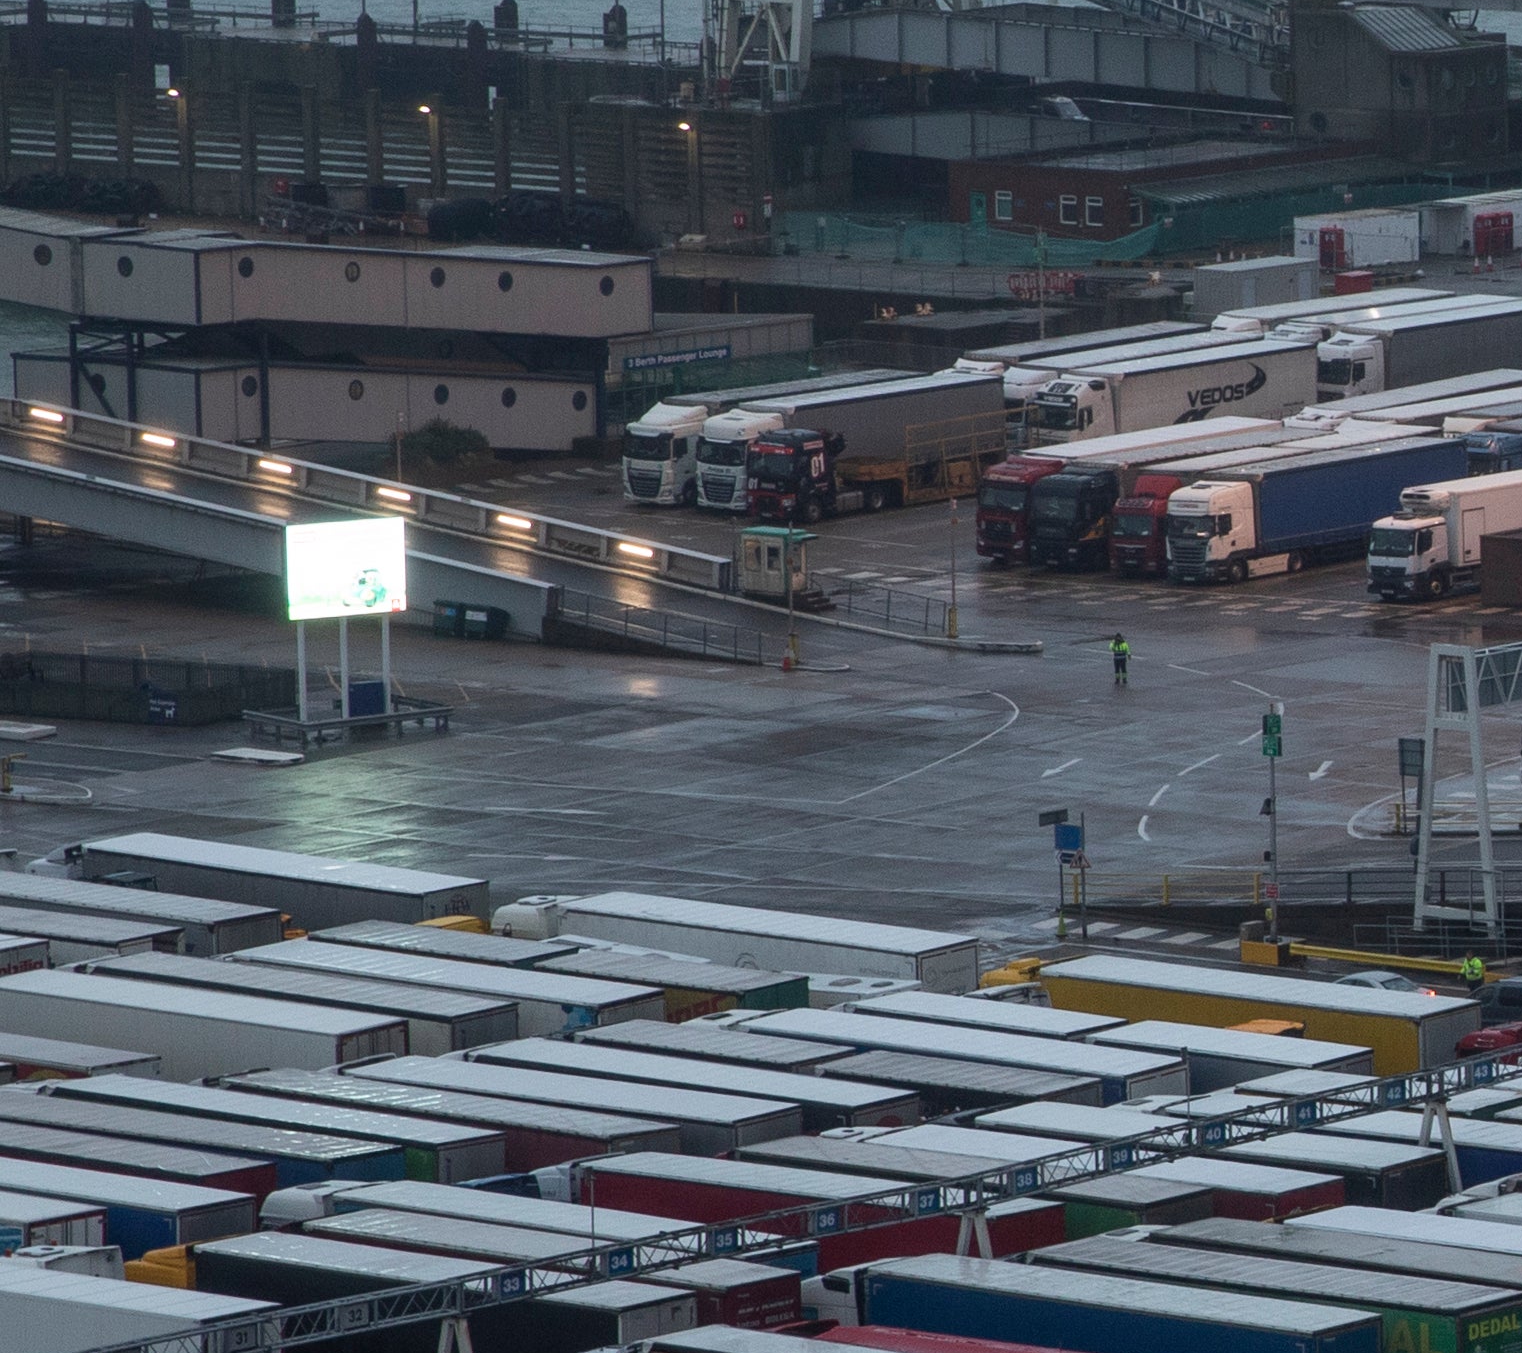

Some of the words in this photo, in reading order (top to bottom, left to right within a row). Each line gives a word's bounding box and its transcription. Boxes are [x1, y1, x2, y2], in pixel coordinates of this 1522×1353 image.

[635, 356, 656, 367] Berth
[658, 351, 698, 366] Passenger
[698, 347, 728, 360] Lounge
[1187, 383, 1245, 408] VEDOS
[810, 452, 825, 479] 01
[1473, 1065, 1488, 1078] 43
[1386, 1087, 1402, 1100] 42
[1298, 1106, 1311, 1119] 41
[1205, 1127, 1222, 1141] 40
[1113, 1149, 1128, 1163] 39
[1017, 1172, 1033, 1187] 38
[920, 1193, 936, 1208] 37
[818, 1212, 835, 1227] 36
[716, 1232, 733, 1247] 35
[610, 1254, 628, 1269] 34
[503, 1277, 520, 1292] 33
[348, 1307, 363, 1323] 32
[1467, 1312, 1521, 1342] DEDAL
[235, 1330, 250, 1345] 31
